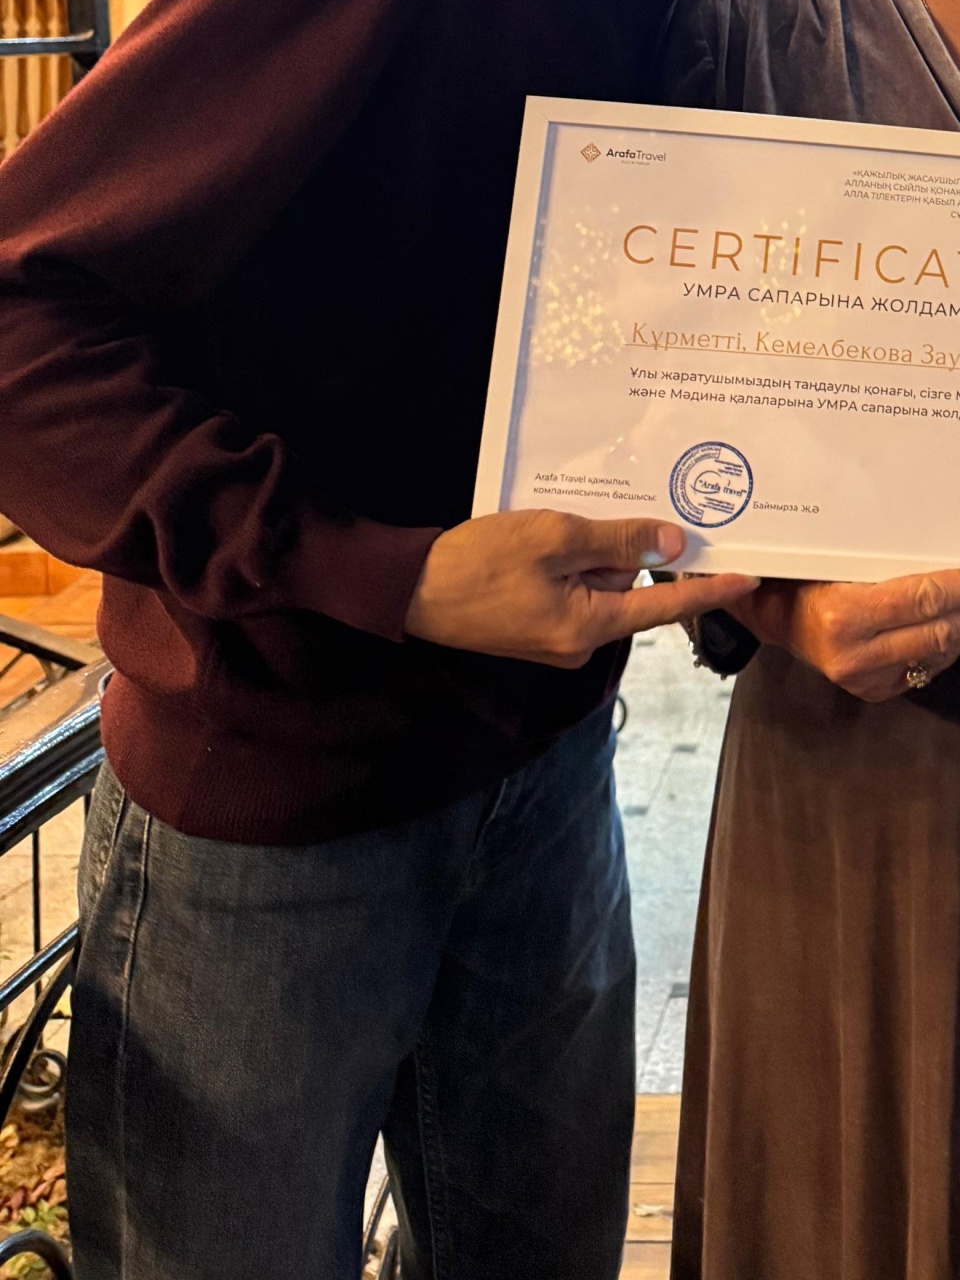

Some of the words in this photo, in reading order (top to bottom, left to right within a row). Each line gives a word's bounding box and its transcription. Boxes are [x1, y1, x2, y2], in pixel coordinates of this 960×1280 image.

[844, 179, 892, 191] АЛЛАНЫҢ
[893, 182, 928, 194] СЫЙЛЫ
[844, 189, 870, 199] АЛЛА
[871, 191, 921, 204] ТІЛЕКТЕРІН
[923, 196, 955, 207] ҚАБЫЛ
[683, 282, 741, 301] УМРА
[748, 287, 865, 310] САПАРЫНА
[755, 330, 913, 363] Кемелбекова
[630, 366, 658, 380] Ұлы
[661, 370, 792, 390] жаратушымыздың
[794, 380, 860, 395] таңдаулы
[863, 385, 916, 400] қонағы,
[919, 387, 952, 400] сізге
[628, 386, 666, 399] және
[670, 388, 726, 403] Мәдина
[729, 393, 814, 409] қалаларына
[817, 398, 858, 412] УМРА
[861, 402, 928, 418] сапарына
[534, 472, 558, 482] Arafa
[560, 473, 586, 484] Travel
